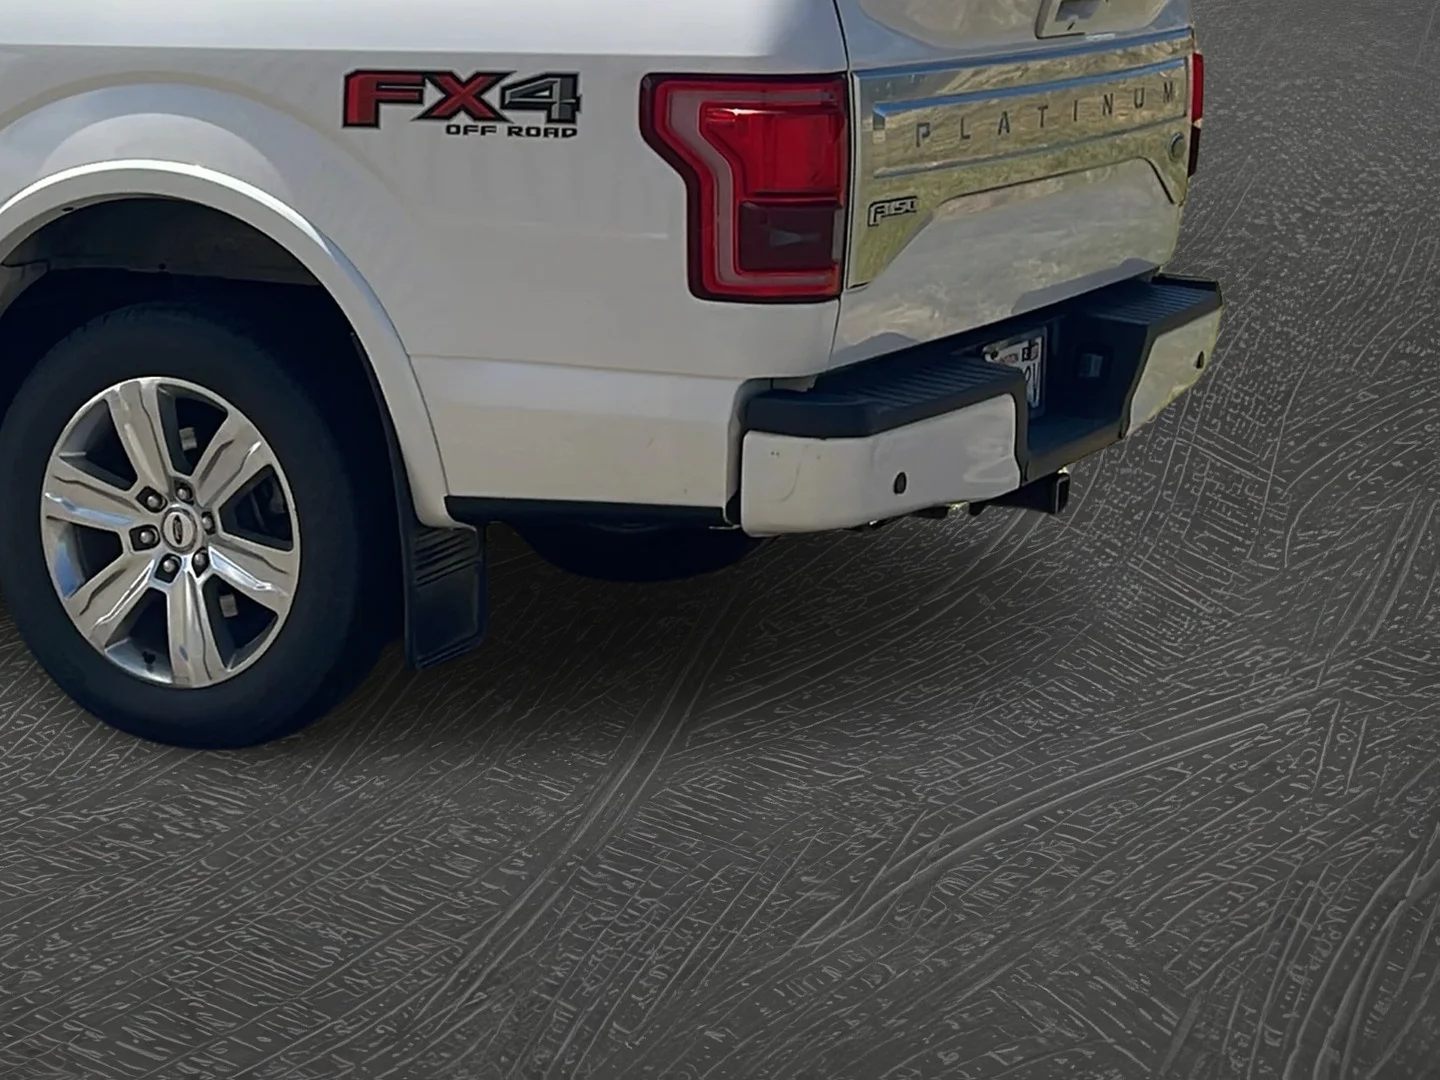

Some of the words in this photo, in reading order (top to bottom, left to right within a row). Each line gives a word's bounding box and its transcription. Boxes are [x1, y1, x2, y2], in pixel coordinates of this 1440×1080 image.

[342, 68, 582, 129] FX4
[915, 80, 1176, 148] PLATINUM
[445, 124, 497, 136] OFF
[506, 125, 578, 138] ROAD
